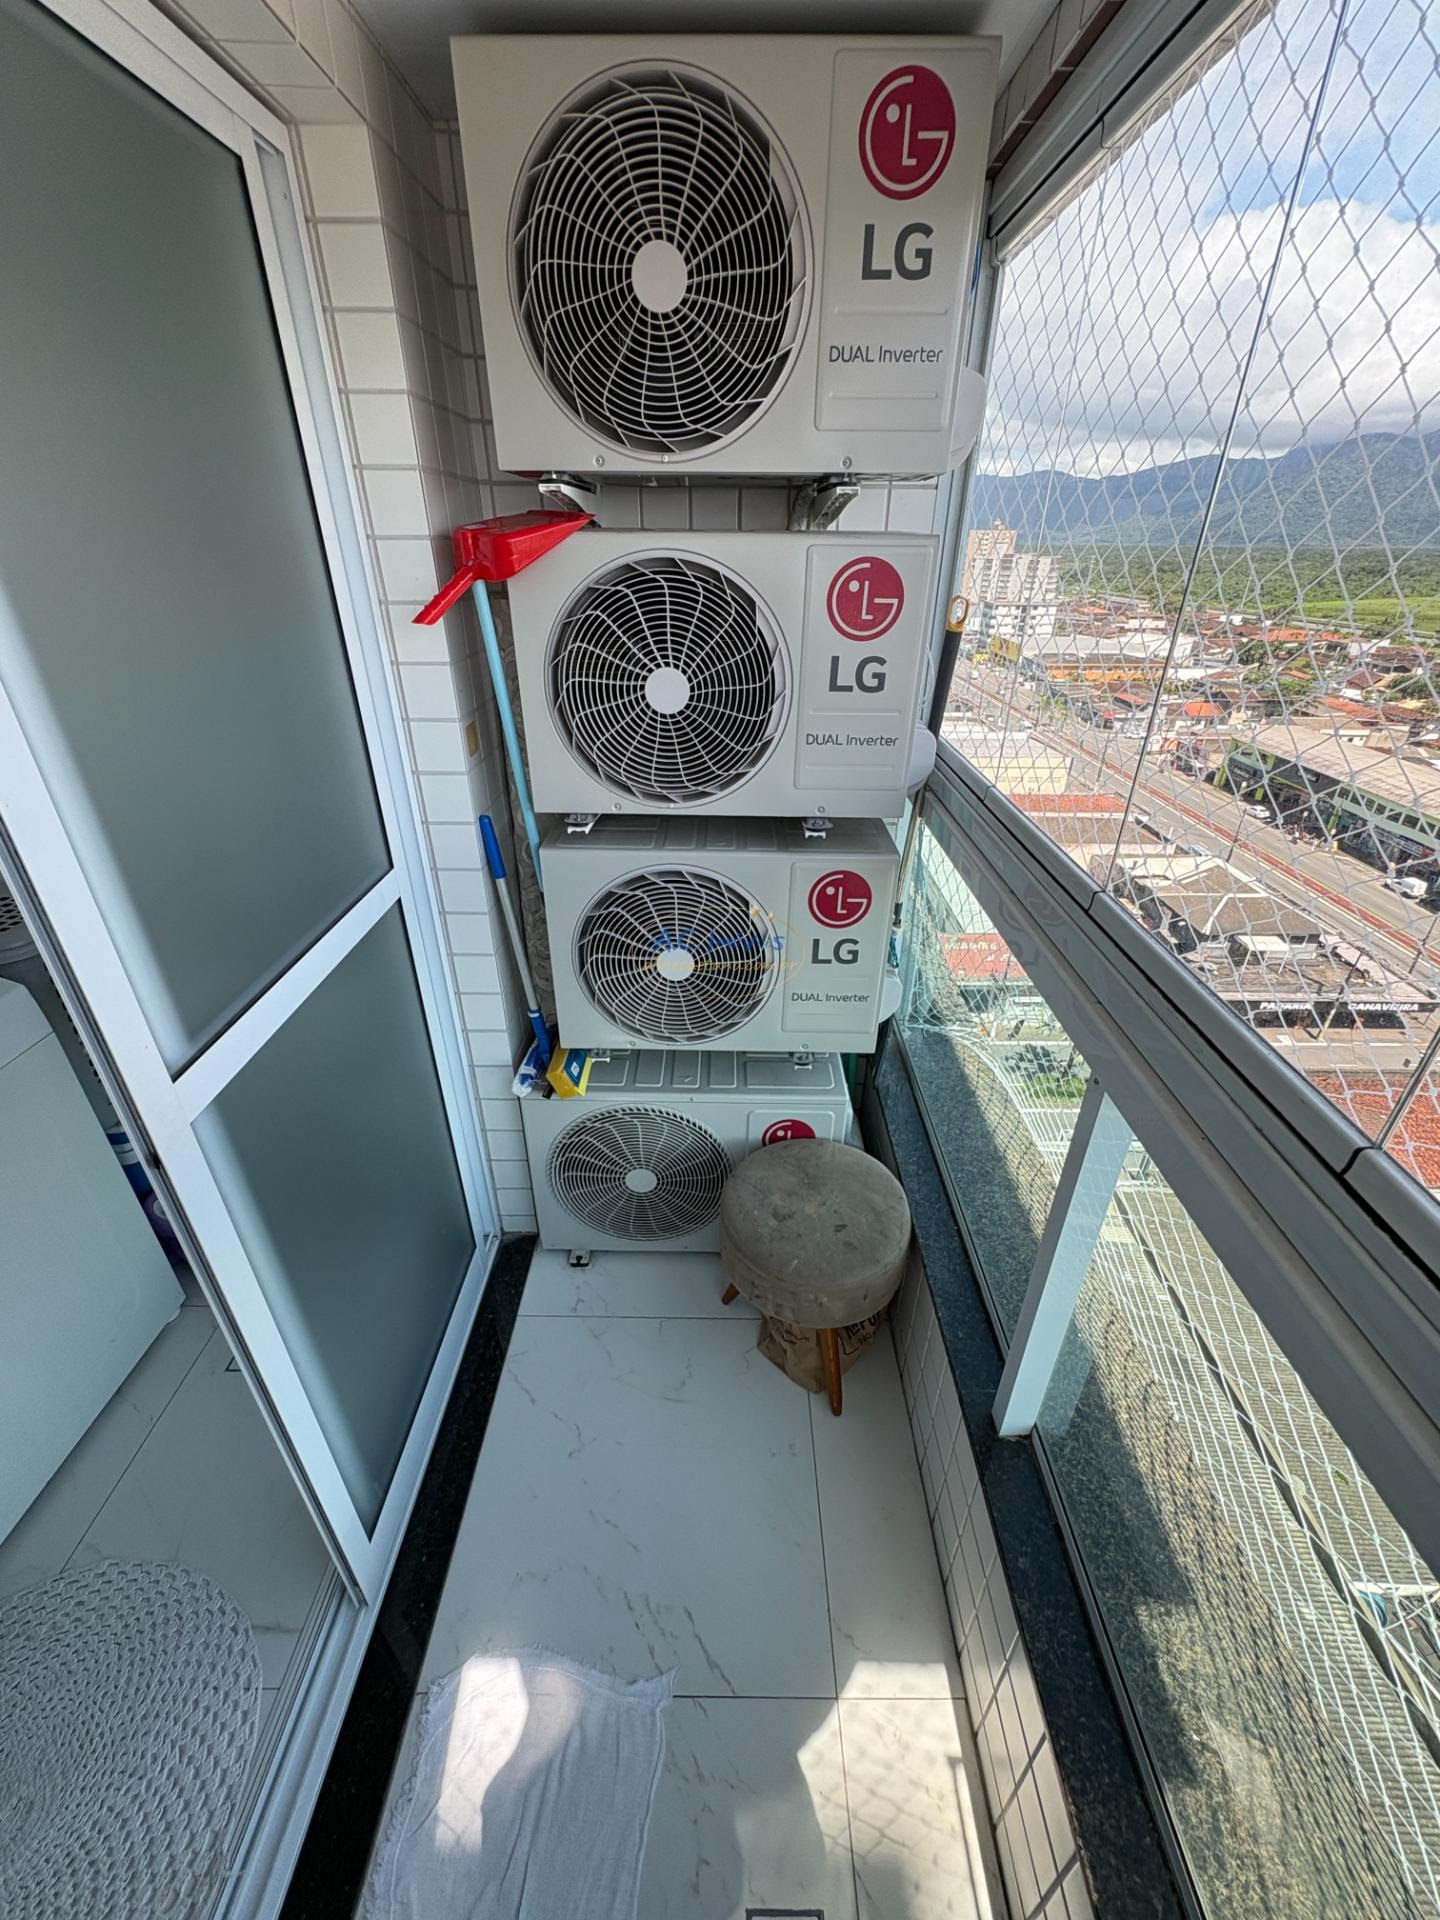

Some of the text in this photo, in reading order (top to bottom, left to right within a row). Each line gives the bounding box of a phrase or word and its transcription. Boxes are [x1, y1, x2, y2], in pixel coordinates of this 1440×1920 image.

[861, 222, 934, 281] LG
[828, 345, 944, 364] DUAL Inverter
[828, 655, 888, 694] LG
[805, 733, 900, 747] DUAL Inverter
[811, 938, 860, 965] LG
[791, 992, 870, 1003] DUAL Inverter
